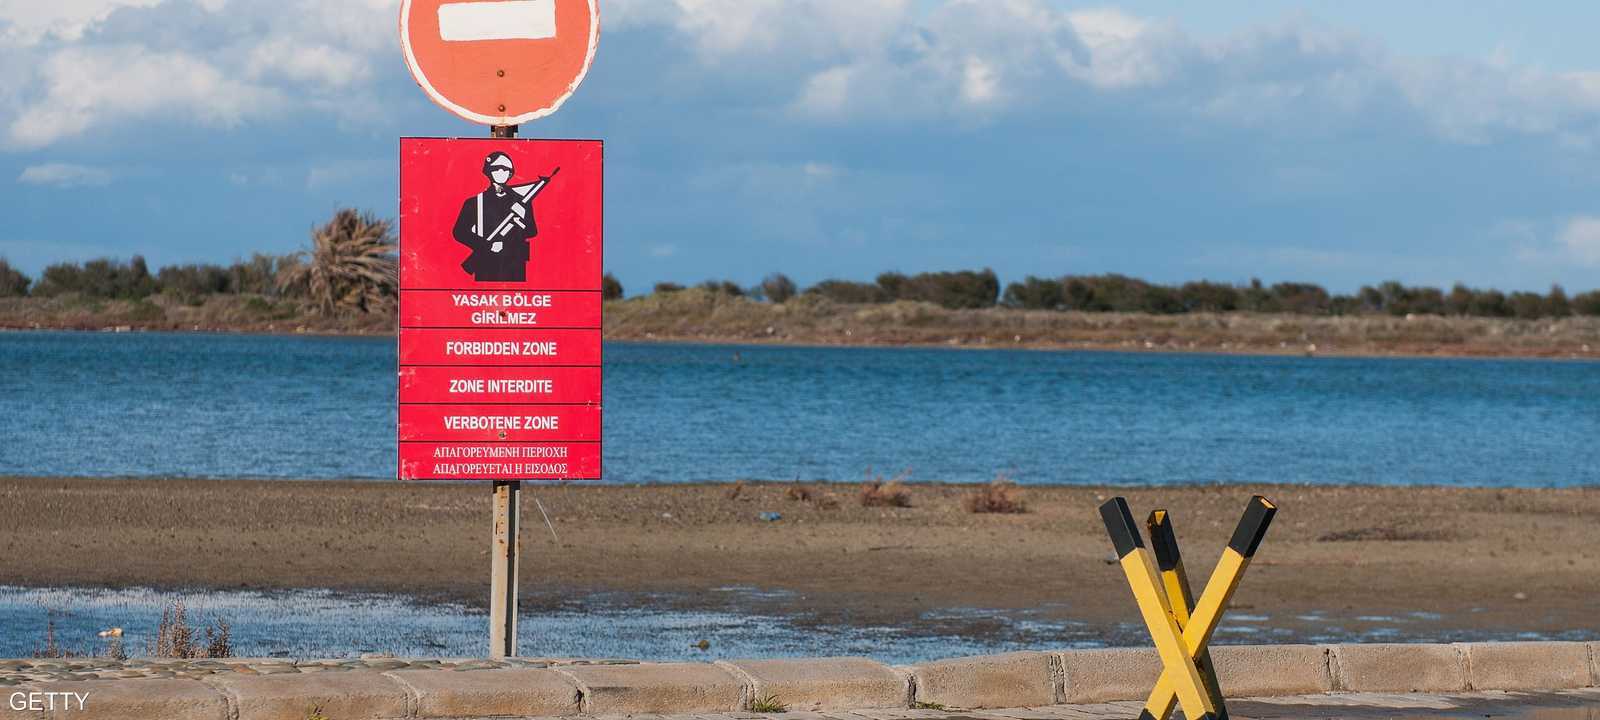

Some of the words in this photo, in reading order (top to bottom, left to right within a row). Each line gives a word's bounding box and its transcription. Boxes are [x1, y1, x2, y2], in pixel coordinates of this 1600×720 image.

[452, 294, 499, 306] YASAK
[502, 292, 552, 306] BÖLGE
[446, 341, 520, 356] FORBIDDEN
[522, 341, 558, 356] ZONE
[449, 379, 485, 393] ZONE
[487, 379, 553, 393] INTERDITE
[444, 415, 521, 430] VERBOTENE
[524, 415, 559, 430] ZONE
[433, 446, 519, 458] ΑΠΑΓΟΡΕΥΜΕΝΗ
[522, 446, 568, 458] ΠΕΡΙΟΧΗ
[433, 463, 513, 475] ΑΠΑΓΟΡΕΥΕΤΑΙ
[515, 463, 522, 475] Η
[525, 463, 568, 475] ΕΙΣΟΔΟΣ
